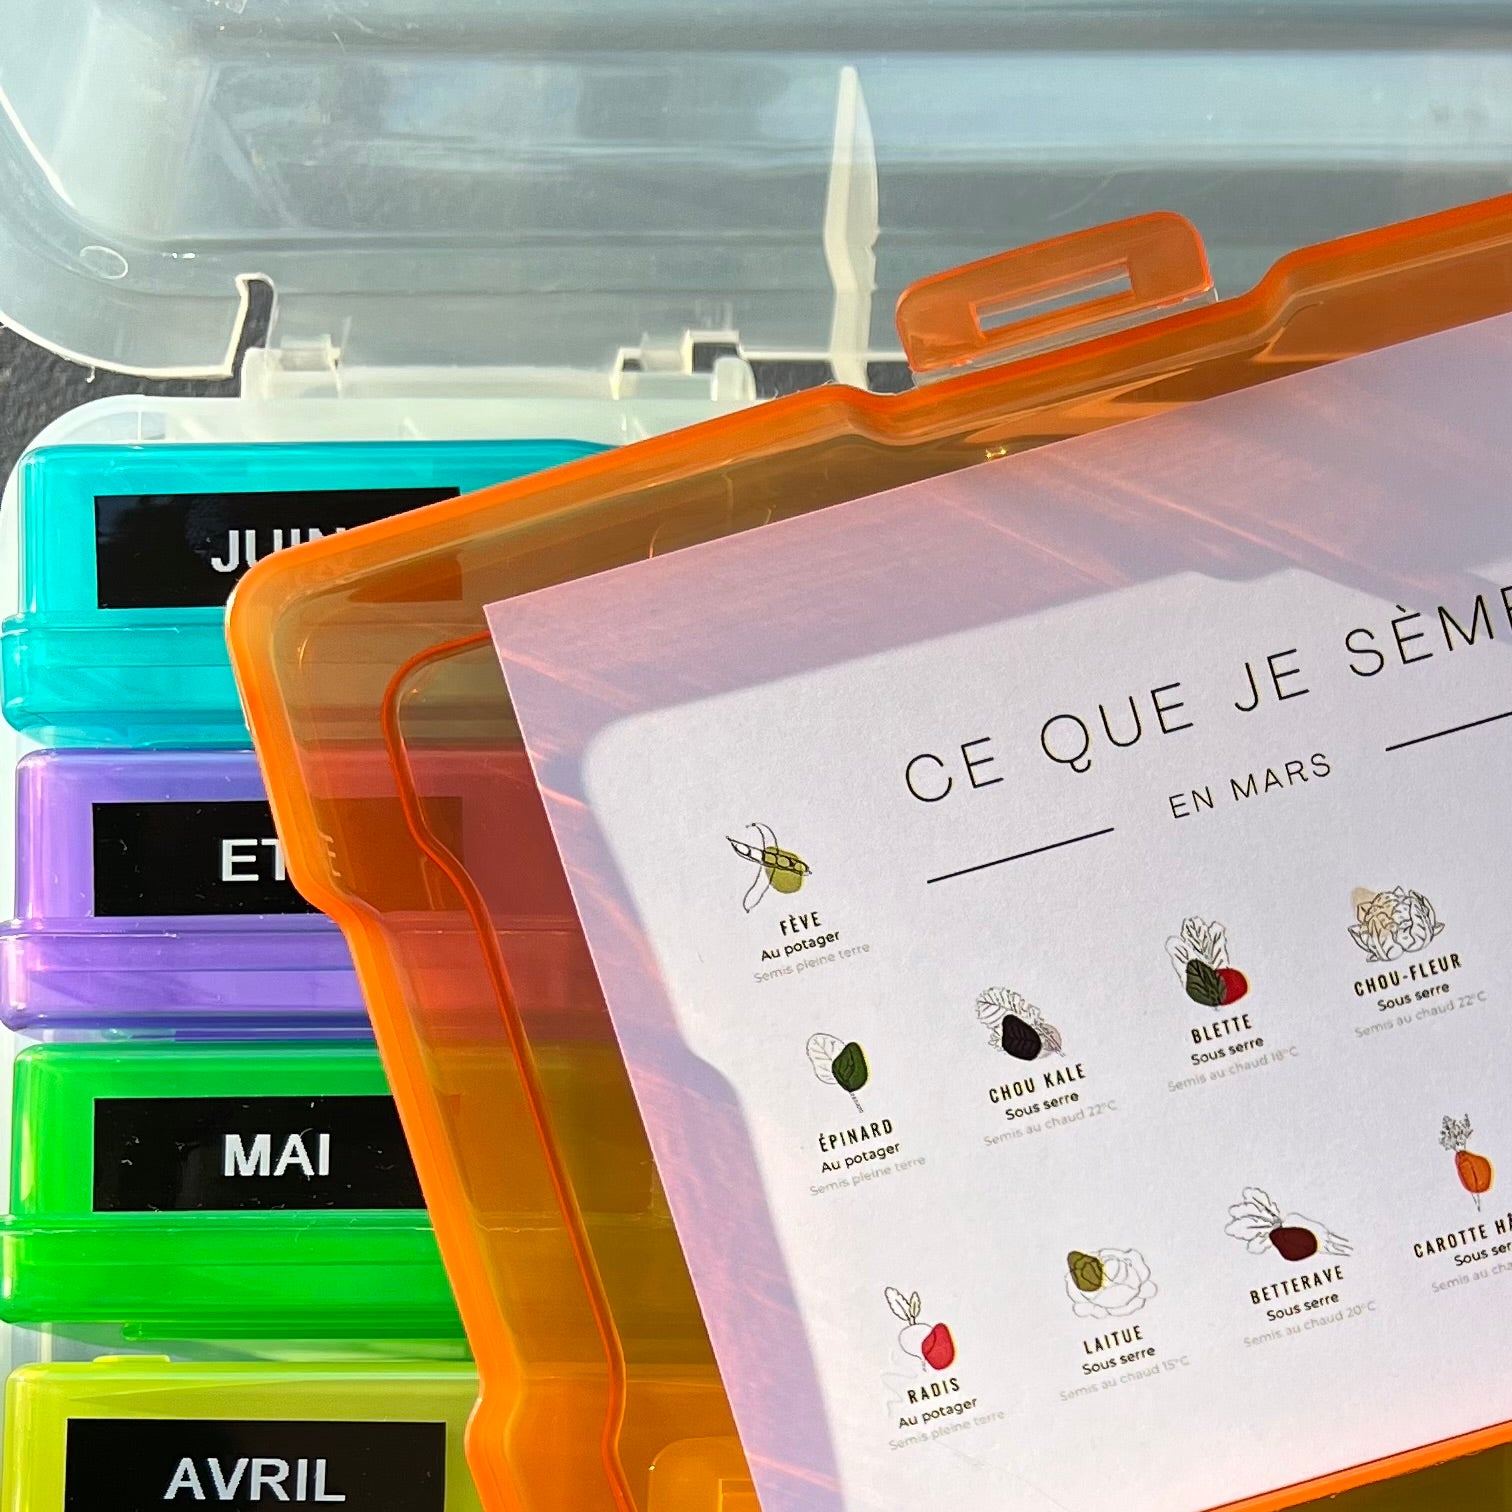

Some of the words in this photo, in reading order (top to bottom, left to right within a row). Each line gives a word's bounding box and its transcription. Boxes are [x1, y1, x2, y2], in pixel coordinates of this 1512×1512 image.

[211, 529, 347, 572] JU
[904, 735, 1004, 803] CE
[1039, 681, 1194, 774] QUE
[1233, 647, 1310, 713] JE
[1167, 785, 1214, 819] EN
[1228, 751, 1331, 802] MARS
[778, 910, 822, 937] FÈVE
[752, 964, 794, 984] Semis
[794, 952, 836, 974] pleine
[836, 942, 871, 960] terre
[760, 948, 781, 962] Au
[782, 930, 840, 958] potager
[1352, 952, 1462, 997] CHOU-FLEUR
[1376, 993, 1412, 1012] Sous
[1413, 982, 1450, 1001] serre
[1189, 1012, 1252, 1045] BLETTE
[1353, 1019, 1394, 1038] Semis
[1395, 1014, 1413, 1027] au
[1414, 998, 1455, 1021] chaud
[1189, 1047, 1226, 1066] Sous
[1227, 1036, 1264, 1055] serre
[987, 1076, 1036, 1104] CHOU
[1042, 1062, 1086, 1089] KALE
[1004, 1102, 1041, 1121] Sous
[1041, 1091, 1079, 1110] serre
[817, 1117, 893, 1153] ÉPINARD
[982, 1128, 1024, 1147] Semis
[1025, 1123, 1042, 1135] au
[1043, 1107, 1086, 1129] chaud
[223, 1134, 331, 1177] MAI
[820, 1160, 841, 1173] Au
[843, 1142, 900, 1169] potager
[808, 1177, 851, 1197] Semis
[850, 1165, 892, 1187] pleine
[893, 1155, 926, 1172] terre
[1412, 1223, 1488, 1259] CAROTTE
[1452, 1248, 1489, 1267] Sous
[1248, 1264, 1344, 1305] BETTERAVE
[1430, 1273, 1470, 1293] Semis
[1472, 1268, 1489, 1281] au
[1265, 1303, 1301, 1322] Sous
[1302, 1292, 1339, 1311] serre
[1082, 1323, 1143, 1355] LAITUE
[1081, 1357, 1117, 1375] Sous
[1118, 1346, 1156, 1365] serre
[906, 1376, 960, 1404] RADIS
[1058, 1383, 1099, 1402] Semis
[1100, 1377, 1118, 1390] au
[1118, 1363, 1160, 1384] chaud
[897, 1415, 919, 1429] Au
[920, 1397, 977, 1424] potager
[164, 1457, 346, 1502] AVRIL
